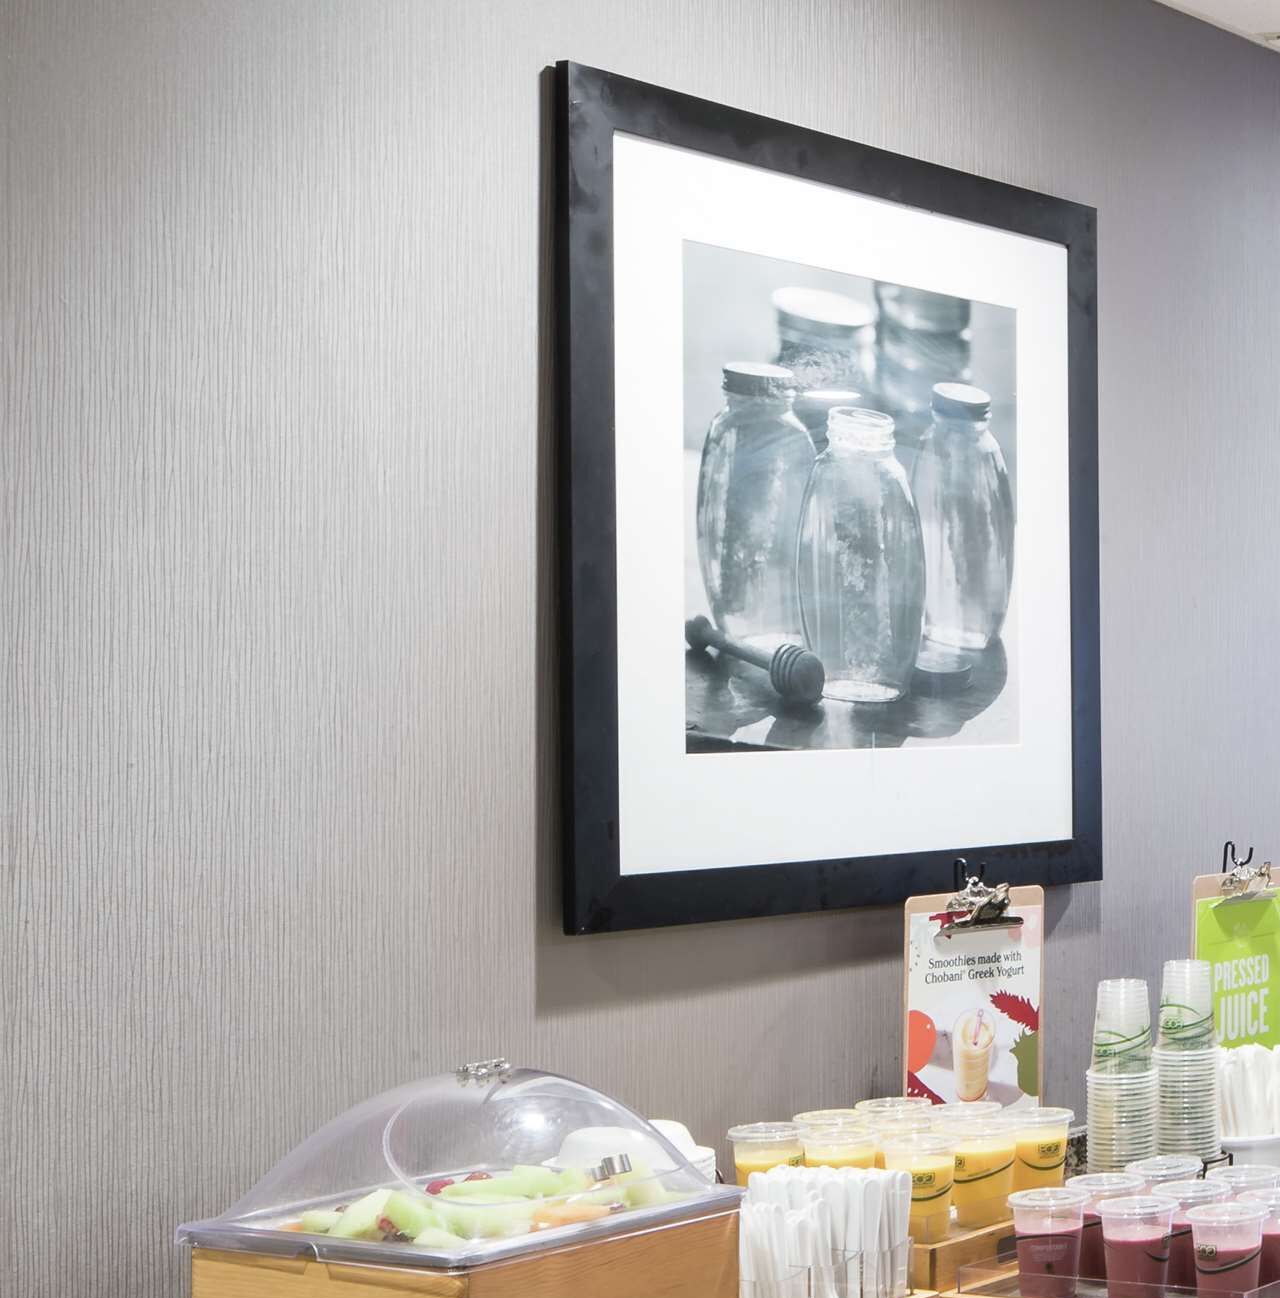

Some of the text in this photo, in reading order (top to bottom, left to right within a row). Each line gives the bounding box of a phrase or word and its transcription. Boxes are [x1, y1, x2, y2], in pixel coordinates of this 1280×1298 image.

[928, 950, 1022, 969] Smoothies made with
[967, 968, 995, 980] Greek
[996, 965, 1025, 978] Yogurt
[1214, 953, 1270, 993] PRESSED
[1214, 988, 1270, 1041] JUICE
